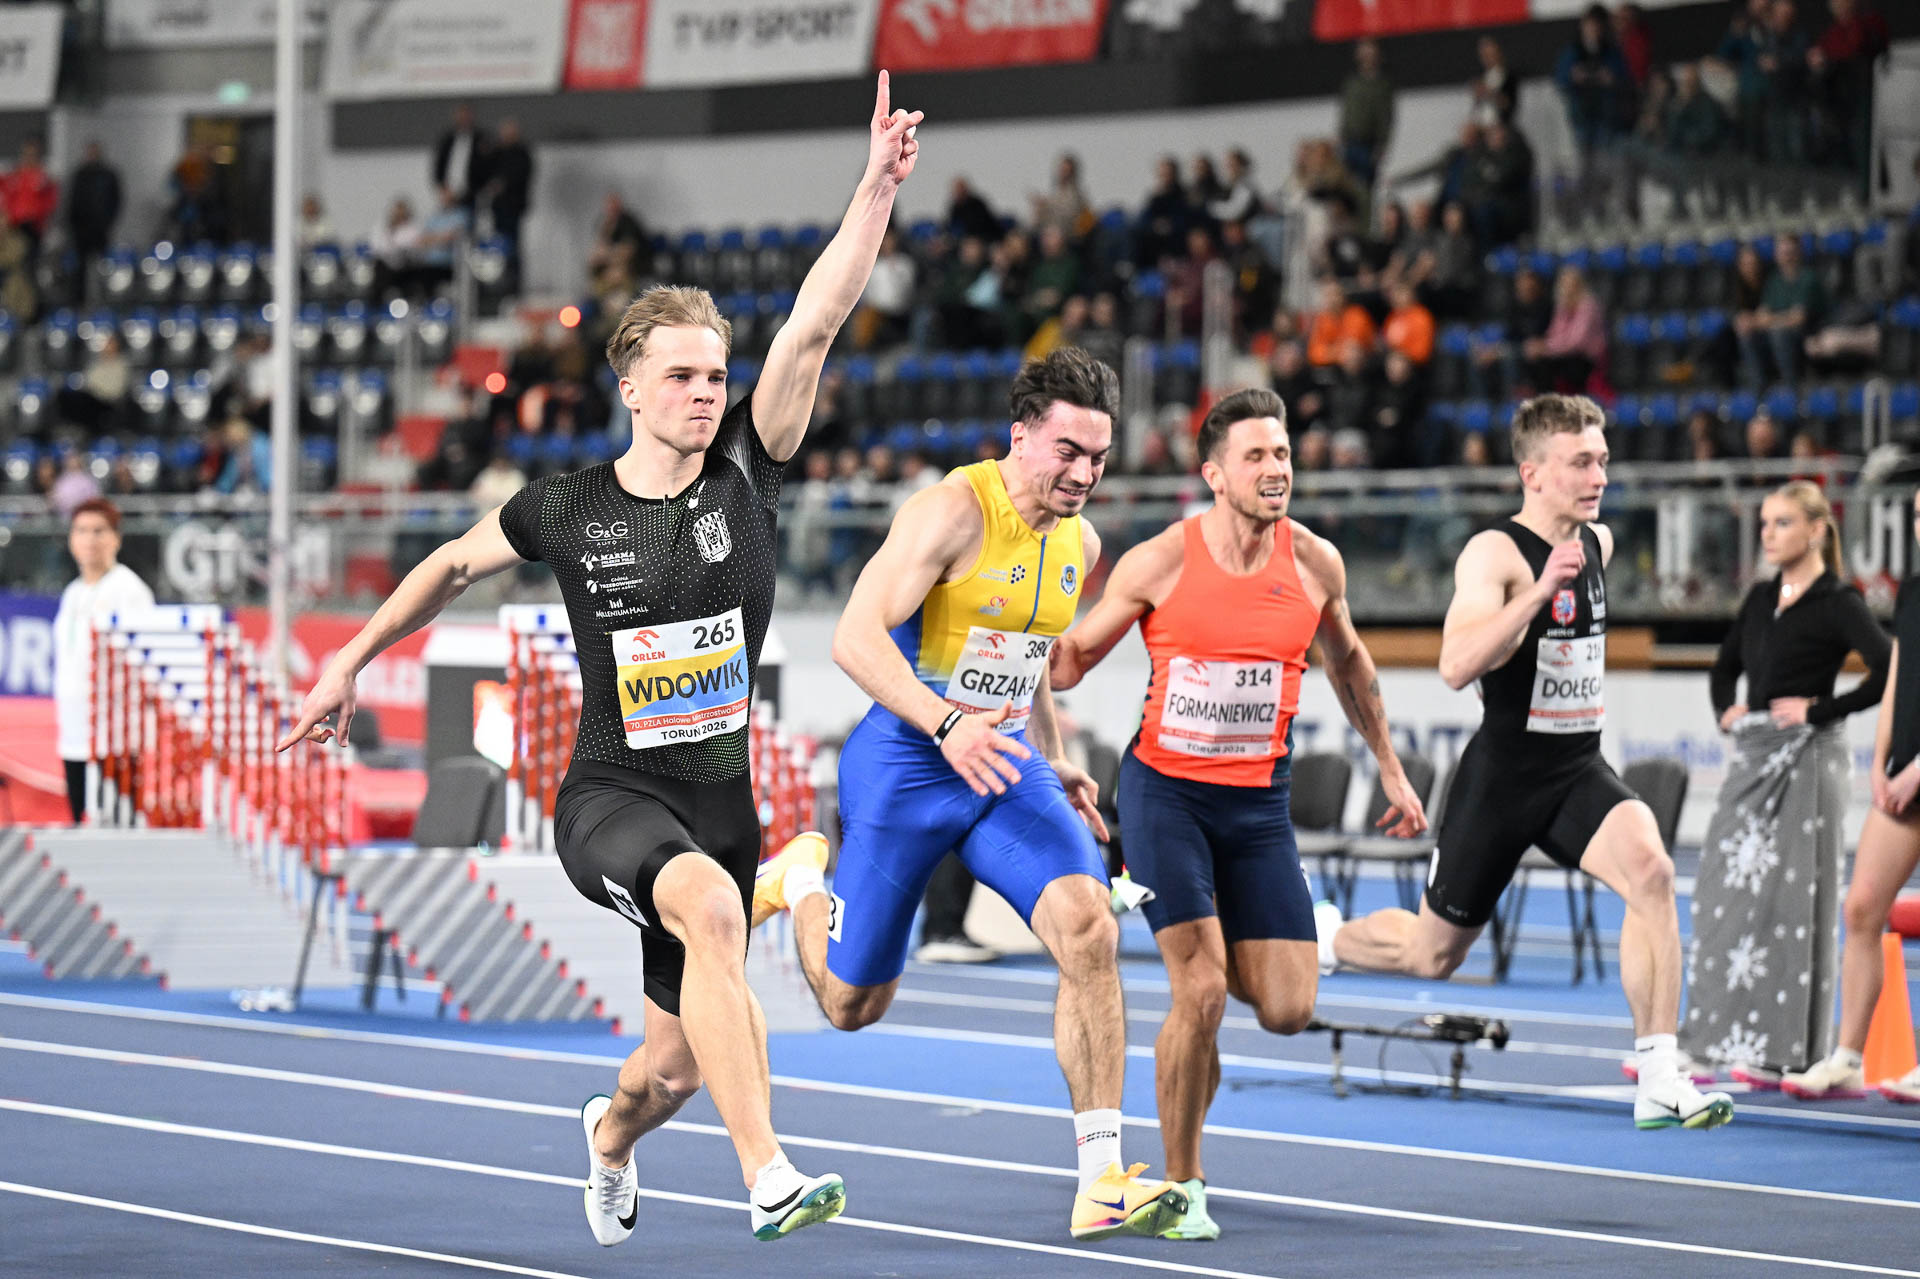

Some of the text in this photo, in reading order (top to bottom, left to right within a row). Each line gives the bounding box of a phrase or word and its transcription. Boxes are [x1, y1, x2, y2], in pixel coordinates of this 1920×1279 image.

[586, 521, 629, 539] G&G
[600, 551, 636, 561] MARMA
[629, 605, 649, 614] HALL
[692, 618, 735, 650] 265
[631, 650, 666, 662] ORLEN
[977, 649, 1005, 660] ORLEN
[624, 658, 744, 704] WDOWIK
[960, 668, 1037, 701] GRZĄKA
[1234, 667, 1273, 688] 314
[1168, 693, 1276, 723] FORMANIEWICZ
[630, 722, 643, 730] 70.
[643, 719, 662, 727] PZLA
[663, 716, 691, 725] Halowe
[691, 708, 732, 721] Mistrzostwa
[660, 720, 728, 740] TORUŃ 2026
[608, 889, 638, 917] 4
